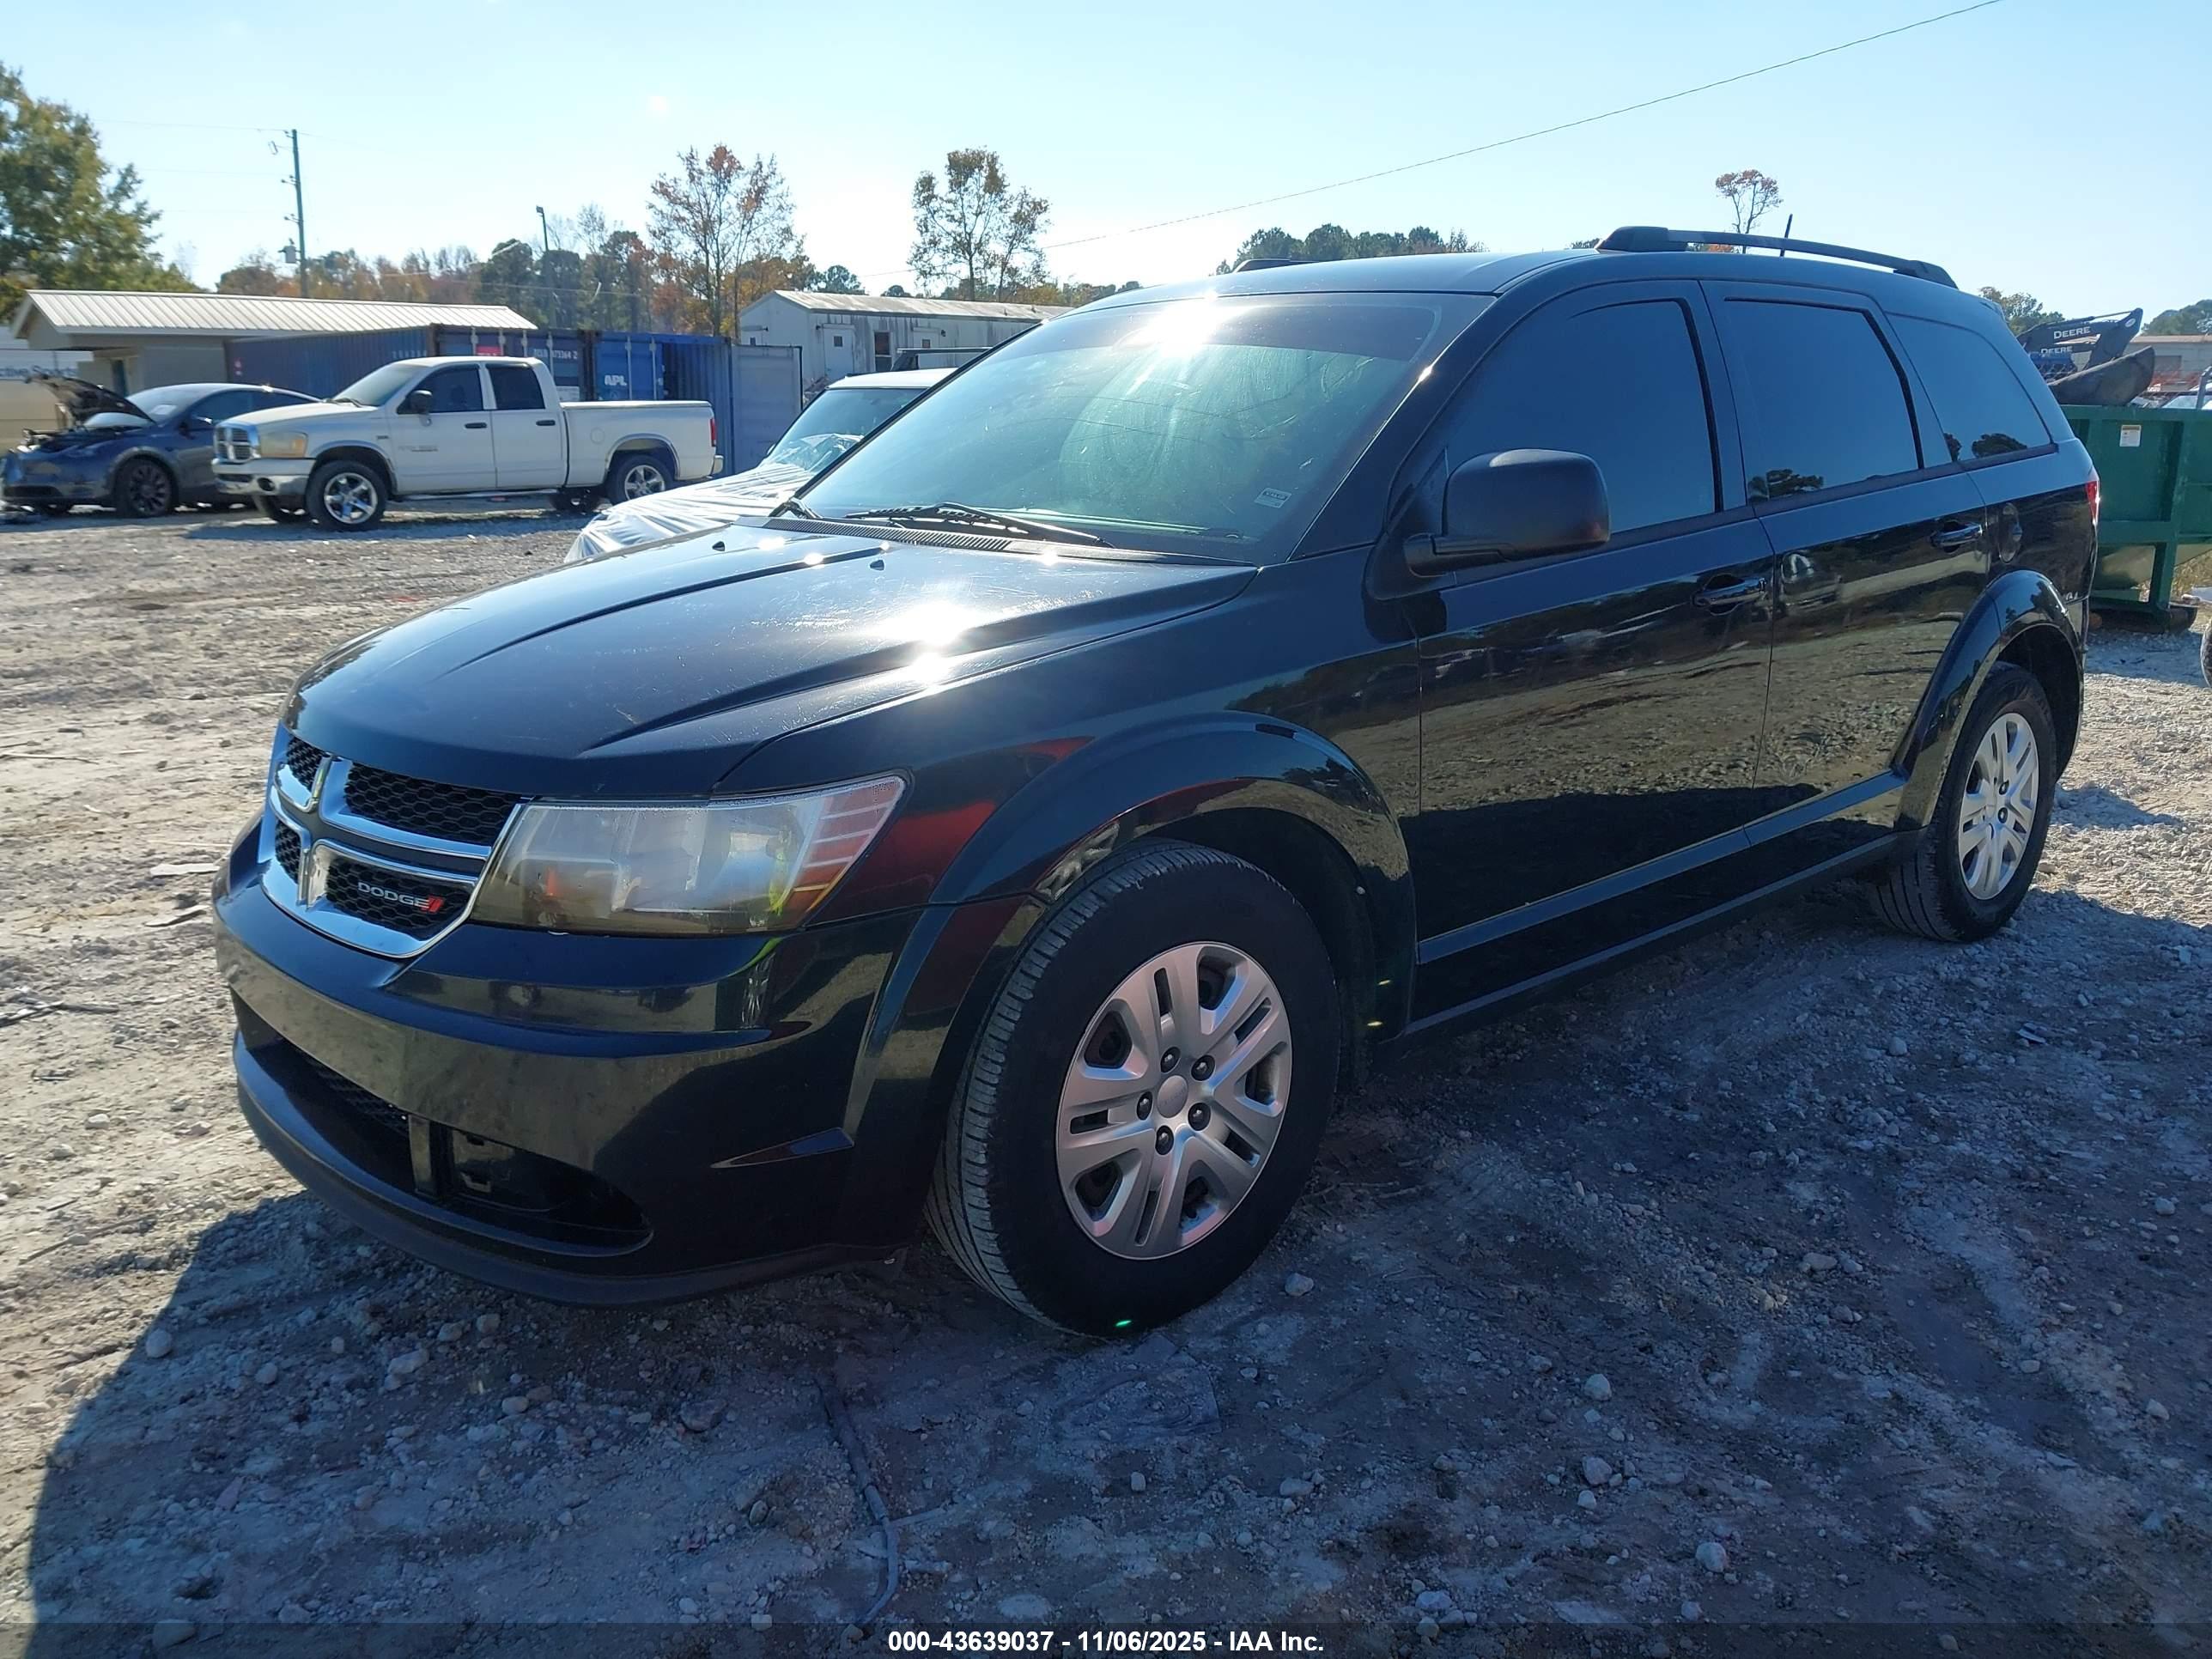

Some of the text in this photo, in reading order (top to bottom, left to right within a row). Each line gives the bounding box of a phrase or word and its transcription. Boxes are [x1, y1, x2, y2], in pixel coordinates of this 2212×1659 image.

[2053, 326, 2091, 339] DEERE
[2040, 346, 2074, 355] DEERE
[604, 374, 628, 386] APL
[357, 881, 429, 909] DODGE
